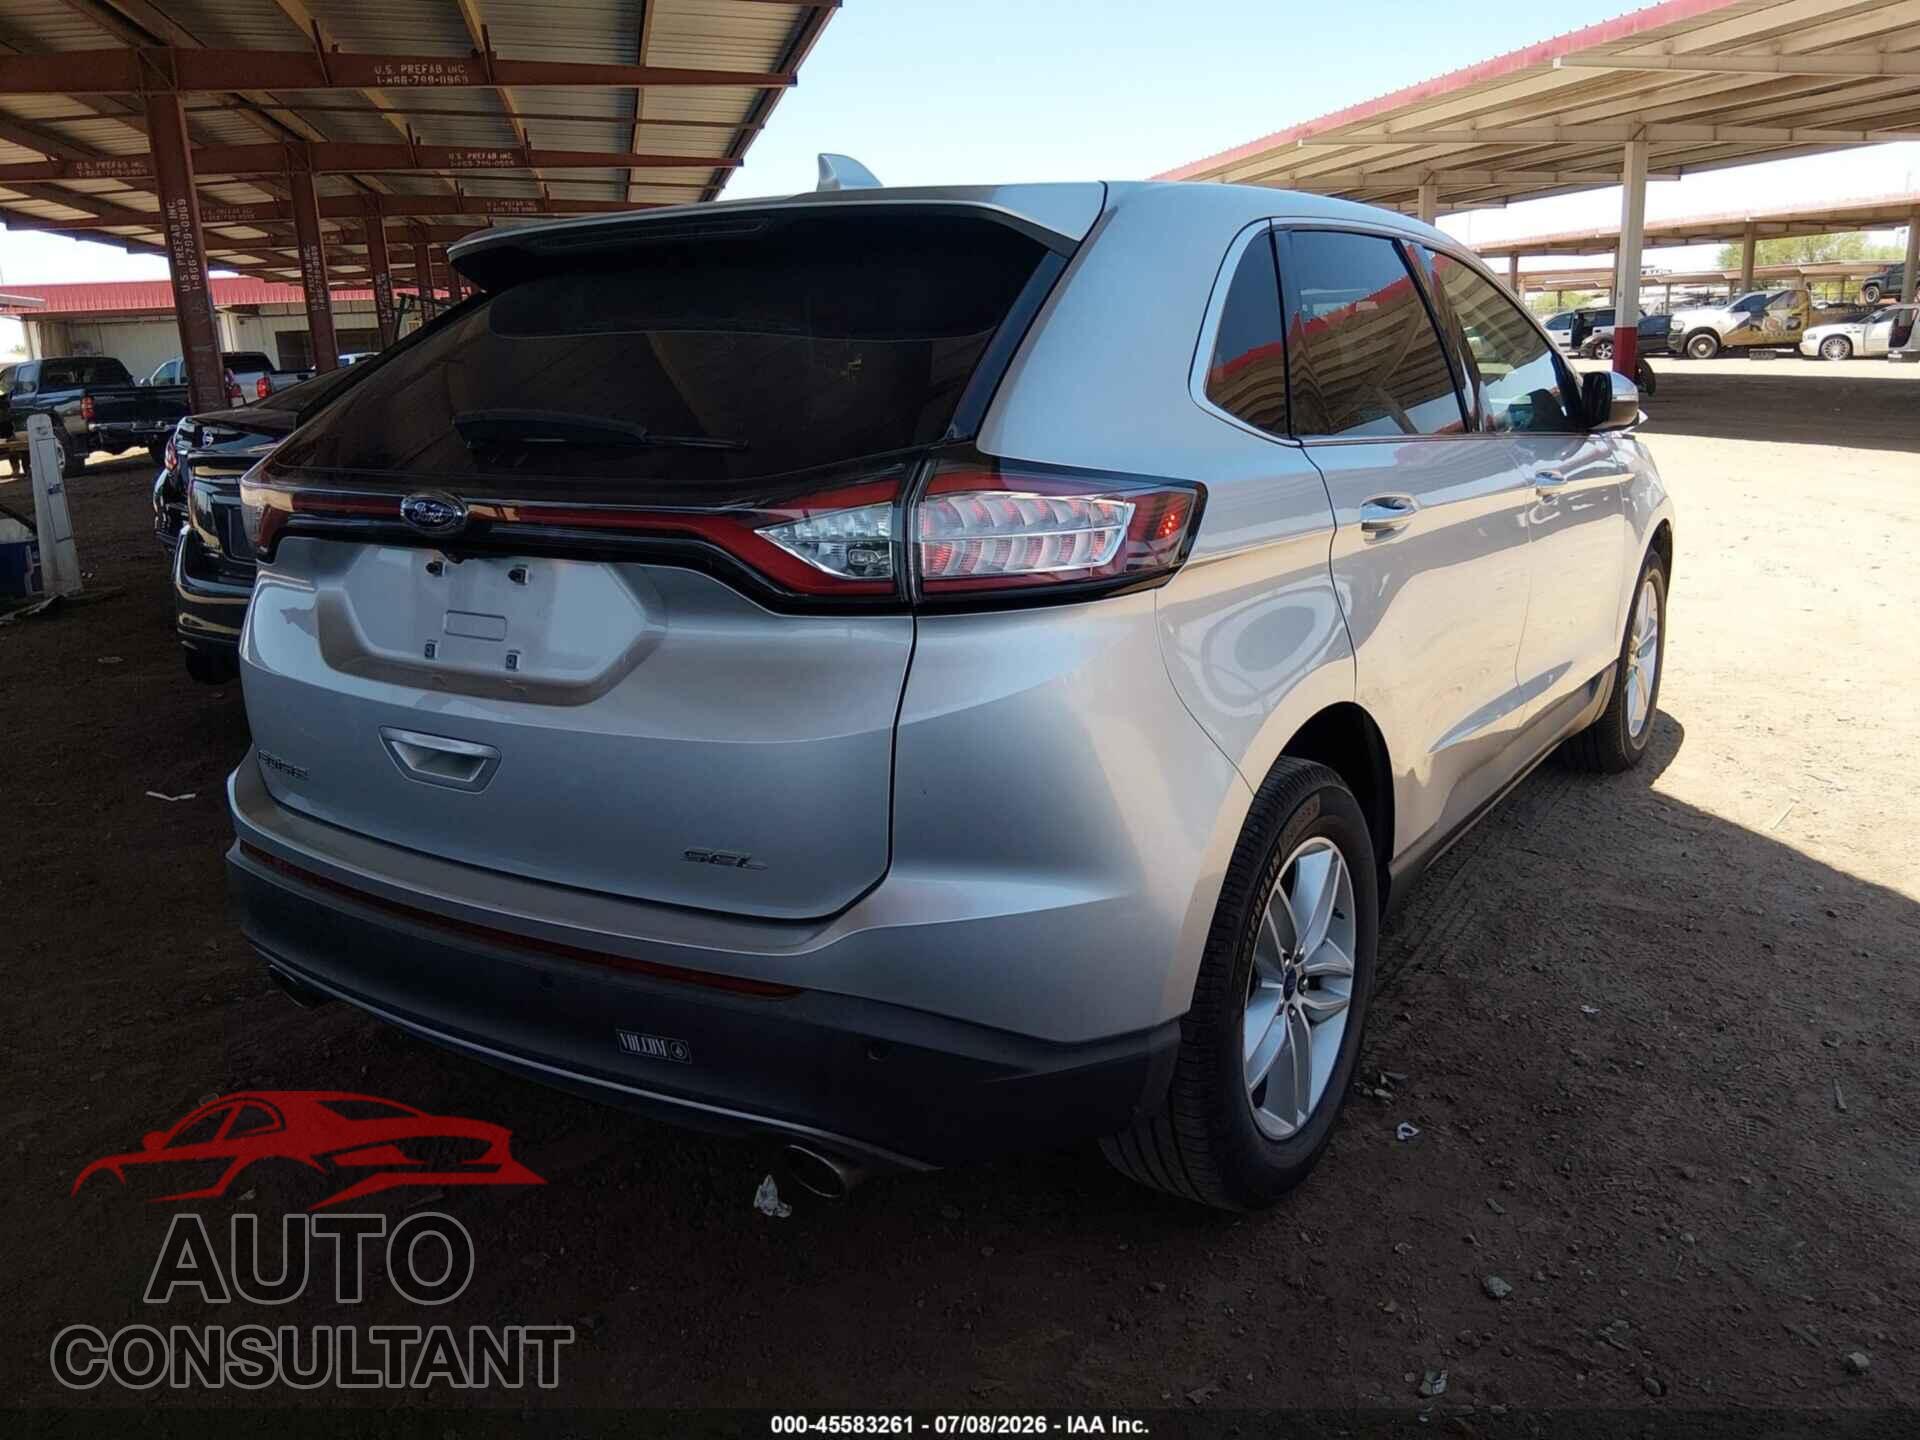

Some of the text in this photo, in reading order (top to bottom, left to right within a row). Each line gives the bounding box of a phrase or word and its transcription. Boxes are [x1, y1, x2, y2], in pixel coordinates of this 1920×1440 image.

[400, 63, 442, 74] PREFAB
[170, 224, 187, 266] PREFAB
[682, 847, 768, 872] SEL
